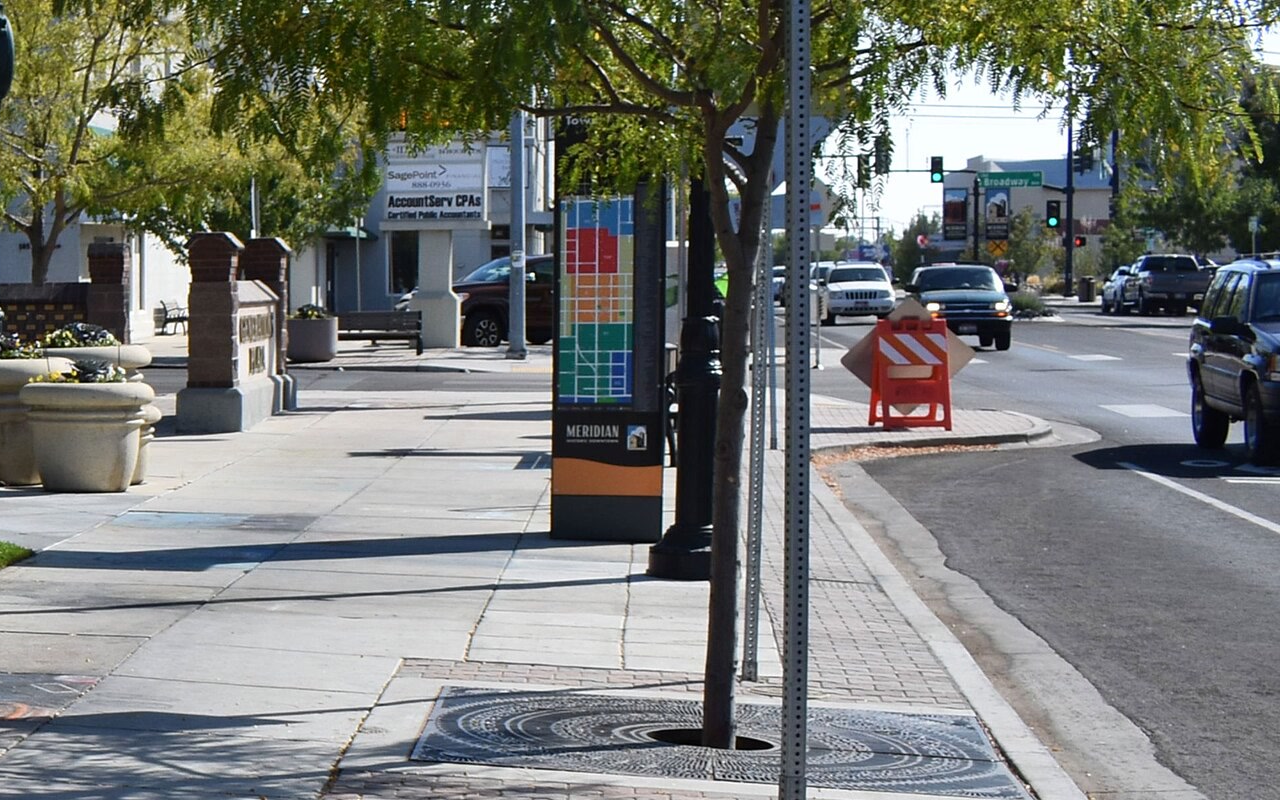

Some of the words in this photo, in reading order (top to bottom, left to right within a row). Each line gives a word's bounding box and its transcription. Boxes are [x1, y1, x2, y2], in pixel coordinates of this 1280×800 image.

[388, 170, 437, 180] SagePoint
[983, 178, 1029, 188] Broadway
[388, 194, 452, 208] AccountServ
[455, 194, 481, 208] CPAs
[388, 211, 417, 219] Certified
[418, 211, 438, 219] Public
[439, 211, 481, 219] Accountants
[566, 424, 619, 438] MERIDIAN
